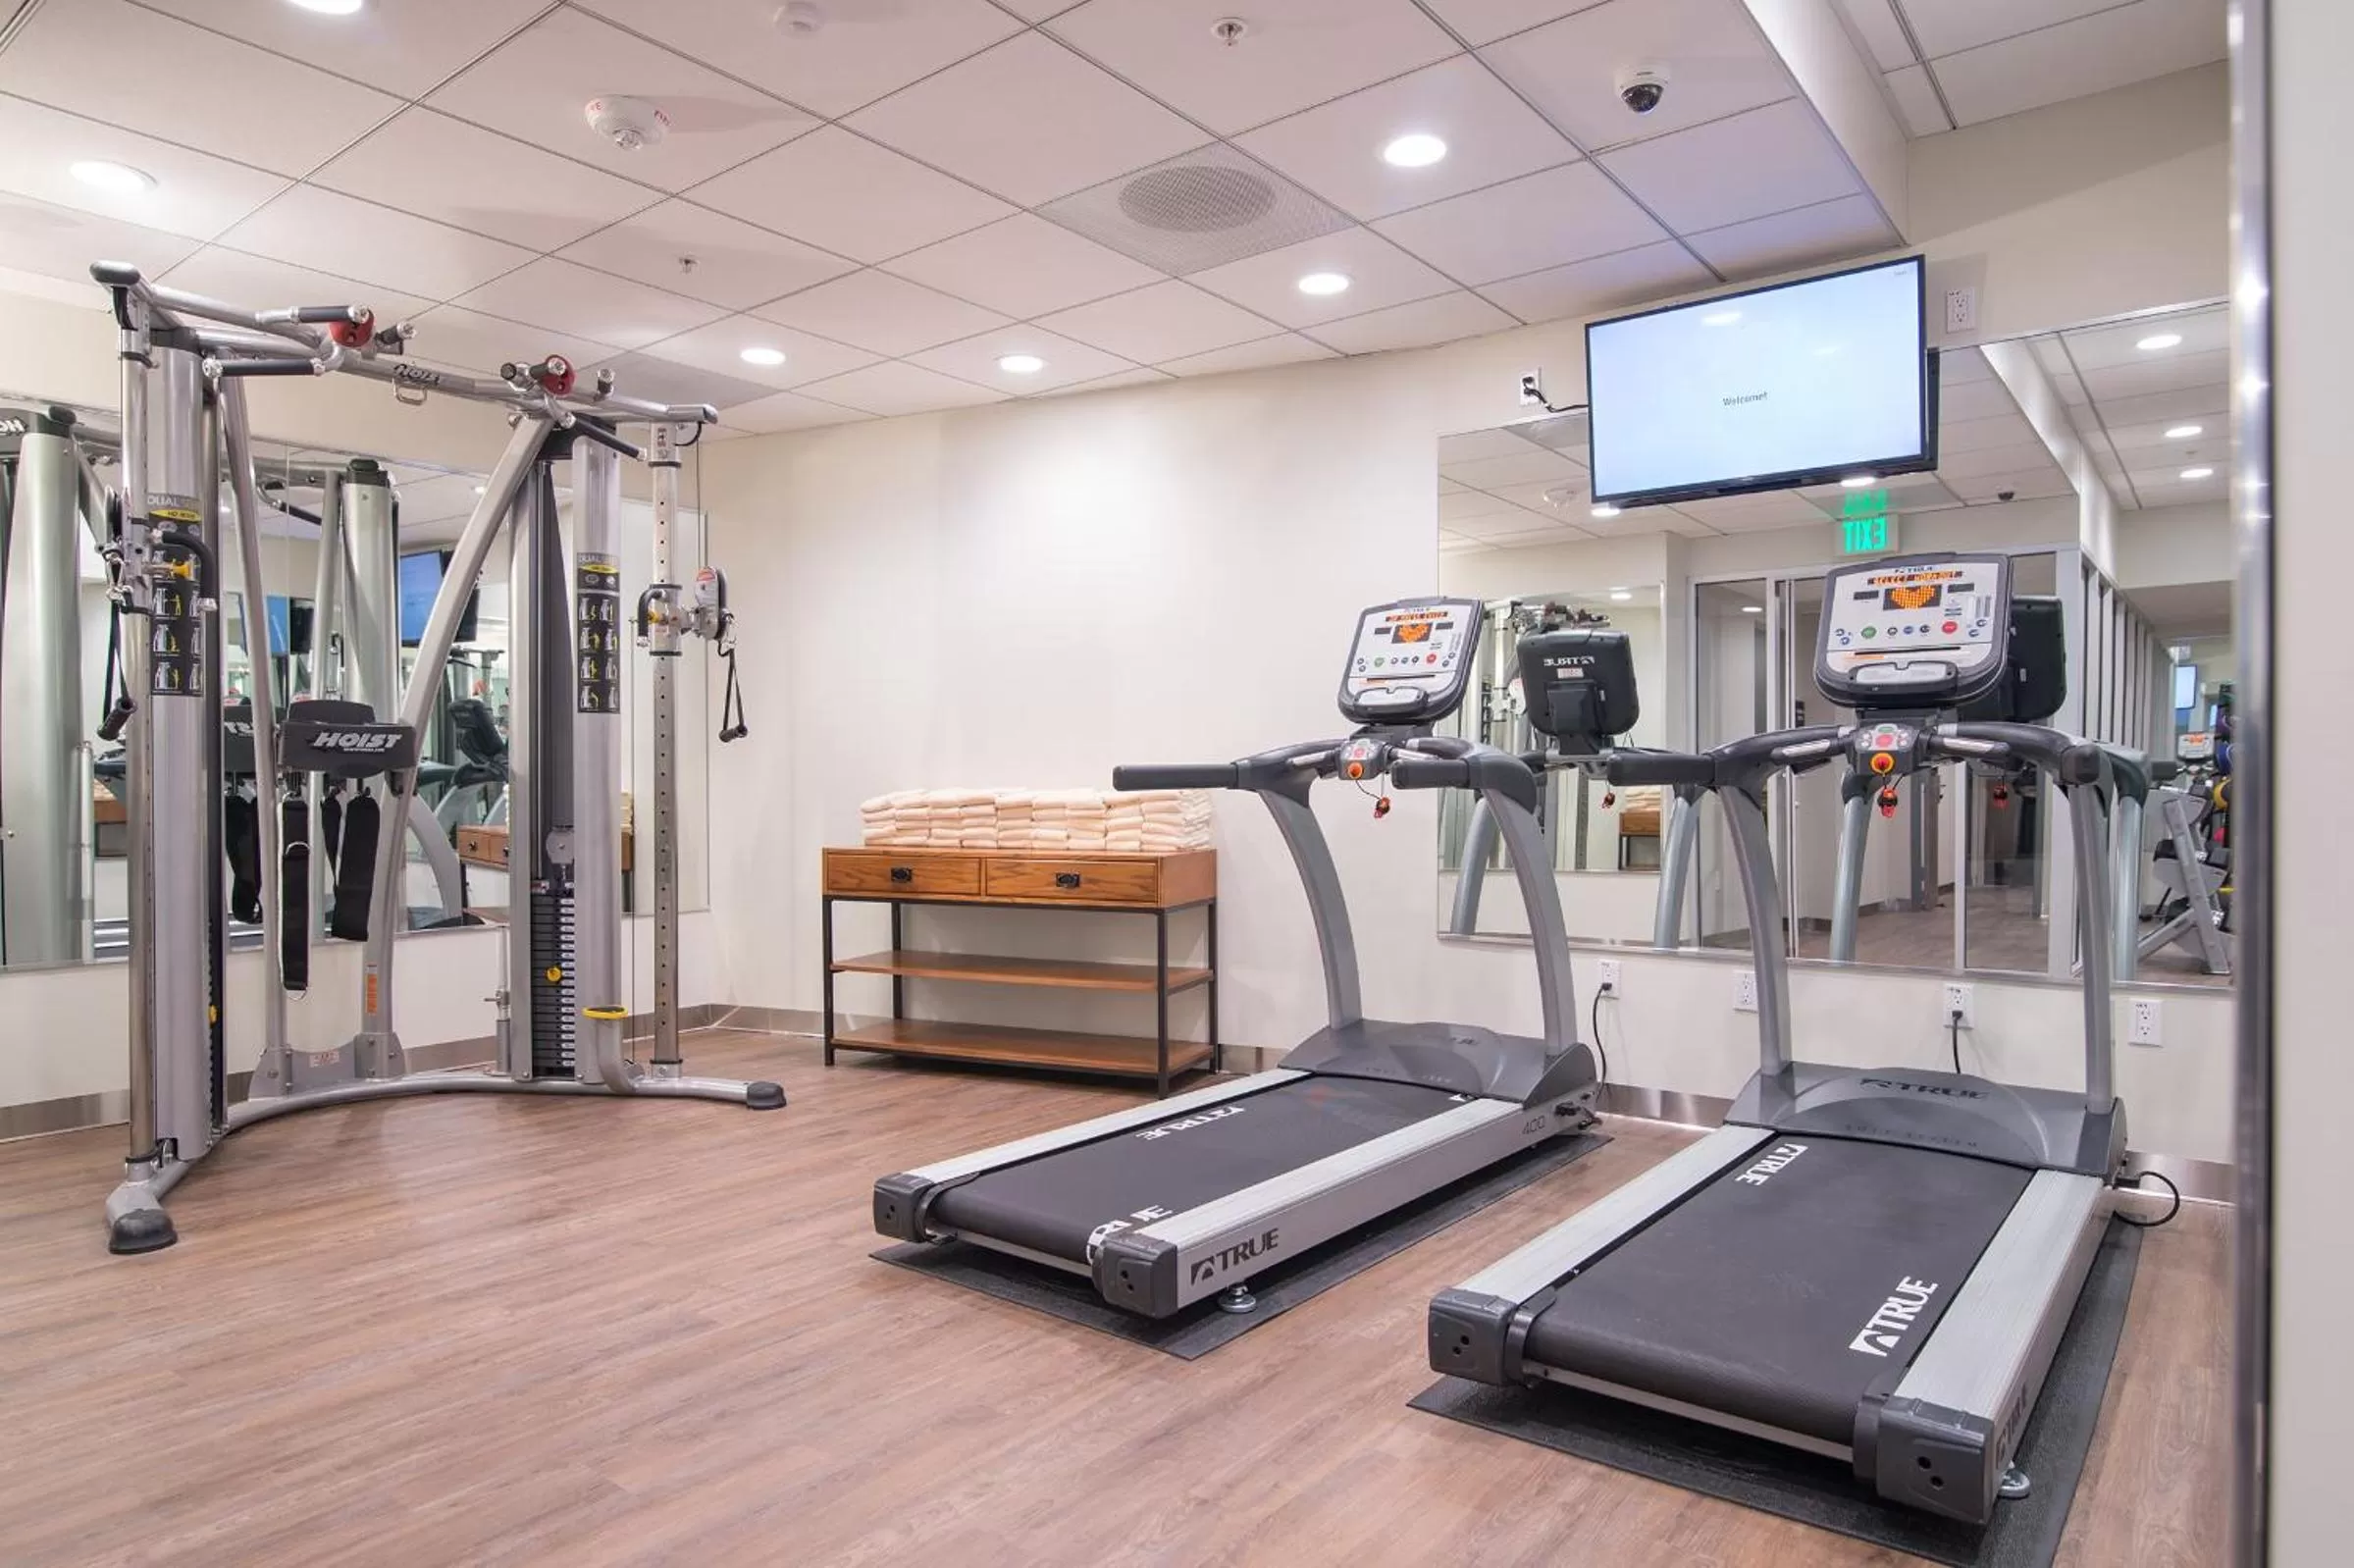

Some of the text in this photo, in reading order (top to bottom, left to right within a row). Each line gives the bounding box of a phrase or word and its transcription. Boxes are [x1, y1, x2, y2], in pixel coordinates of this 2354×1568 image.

[313, 731, 403, 749] HOIST
[1895, 1080, 1991, 1100] TRUE
[1522, 1115, 1545, 1135] 400
[1735, 1154, 1796, 1186] TRUE
[1215, 1227, 1280, 1272] TRUE
[1865, 1276, 1938, 1331] TRUE
